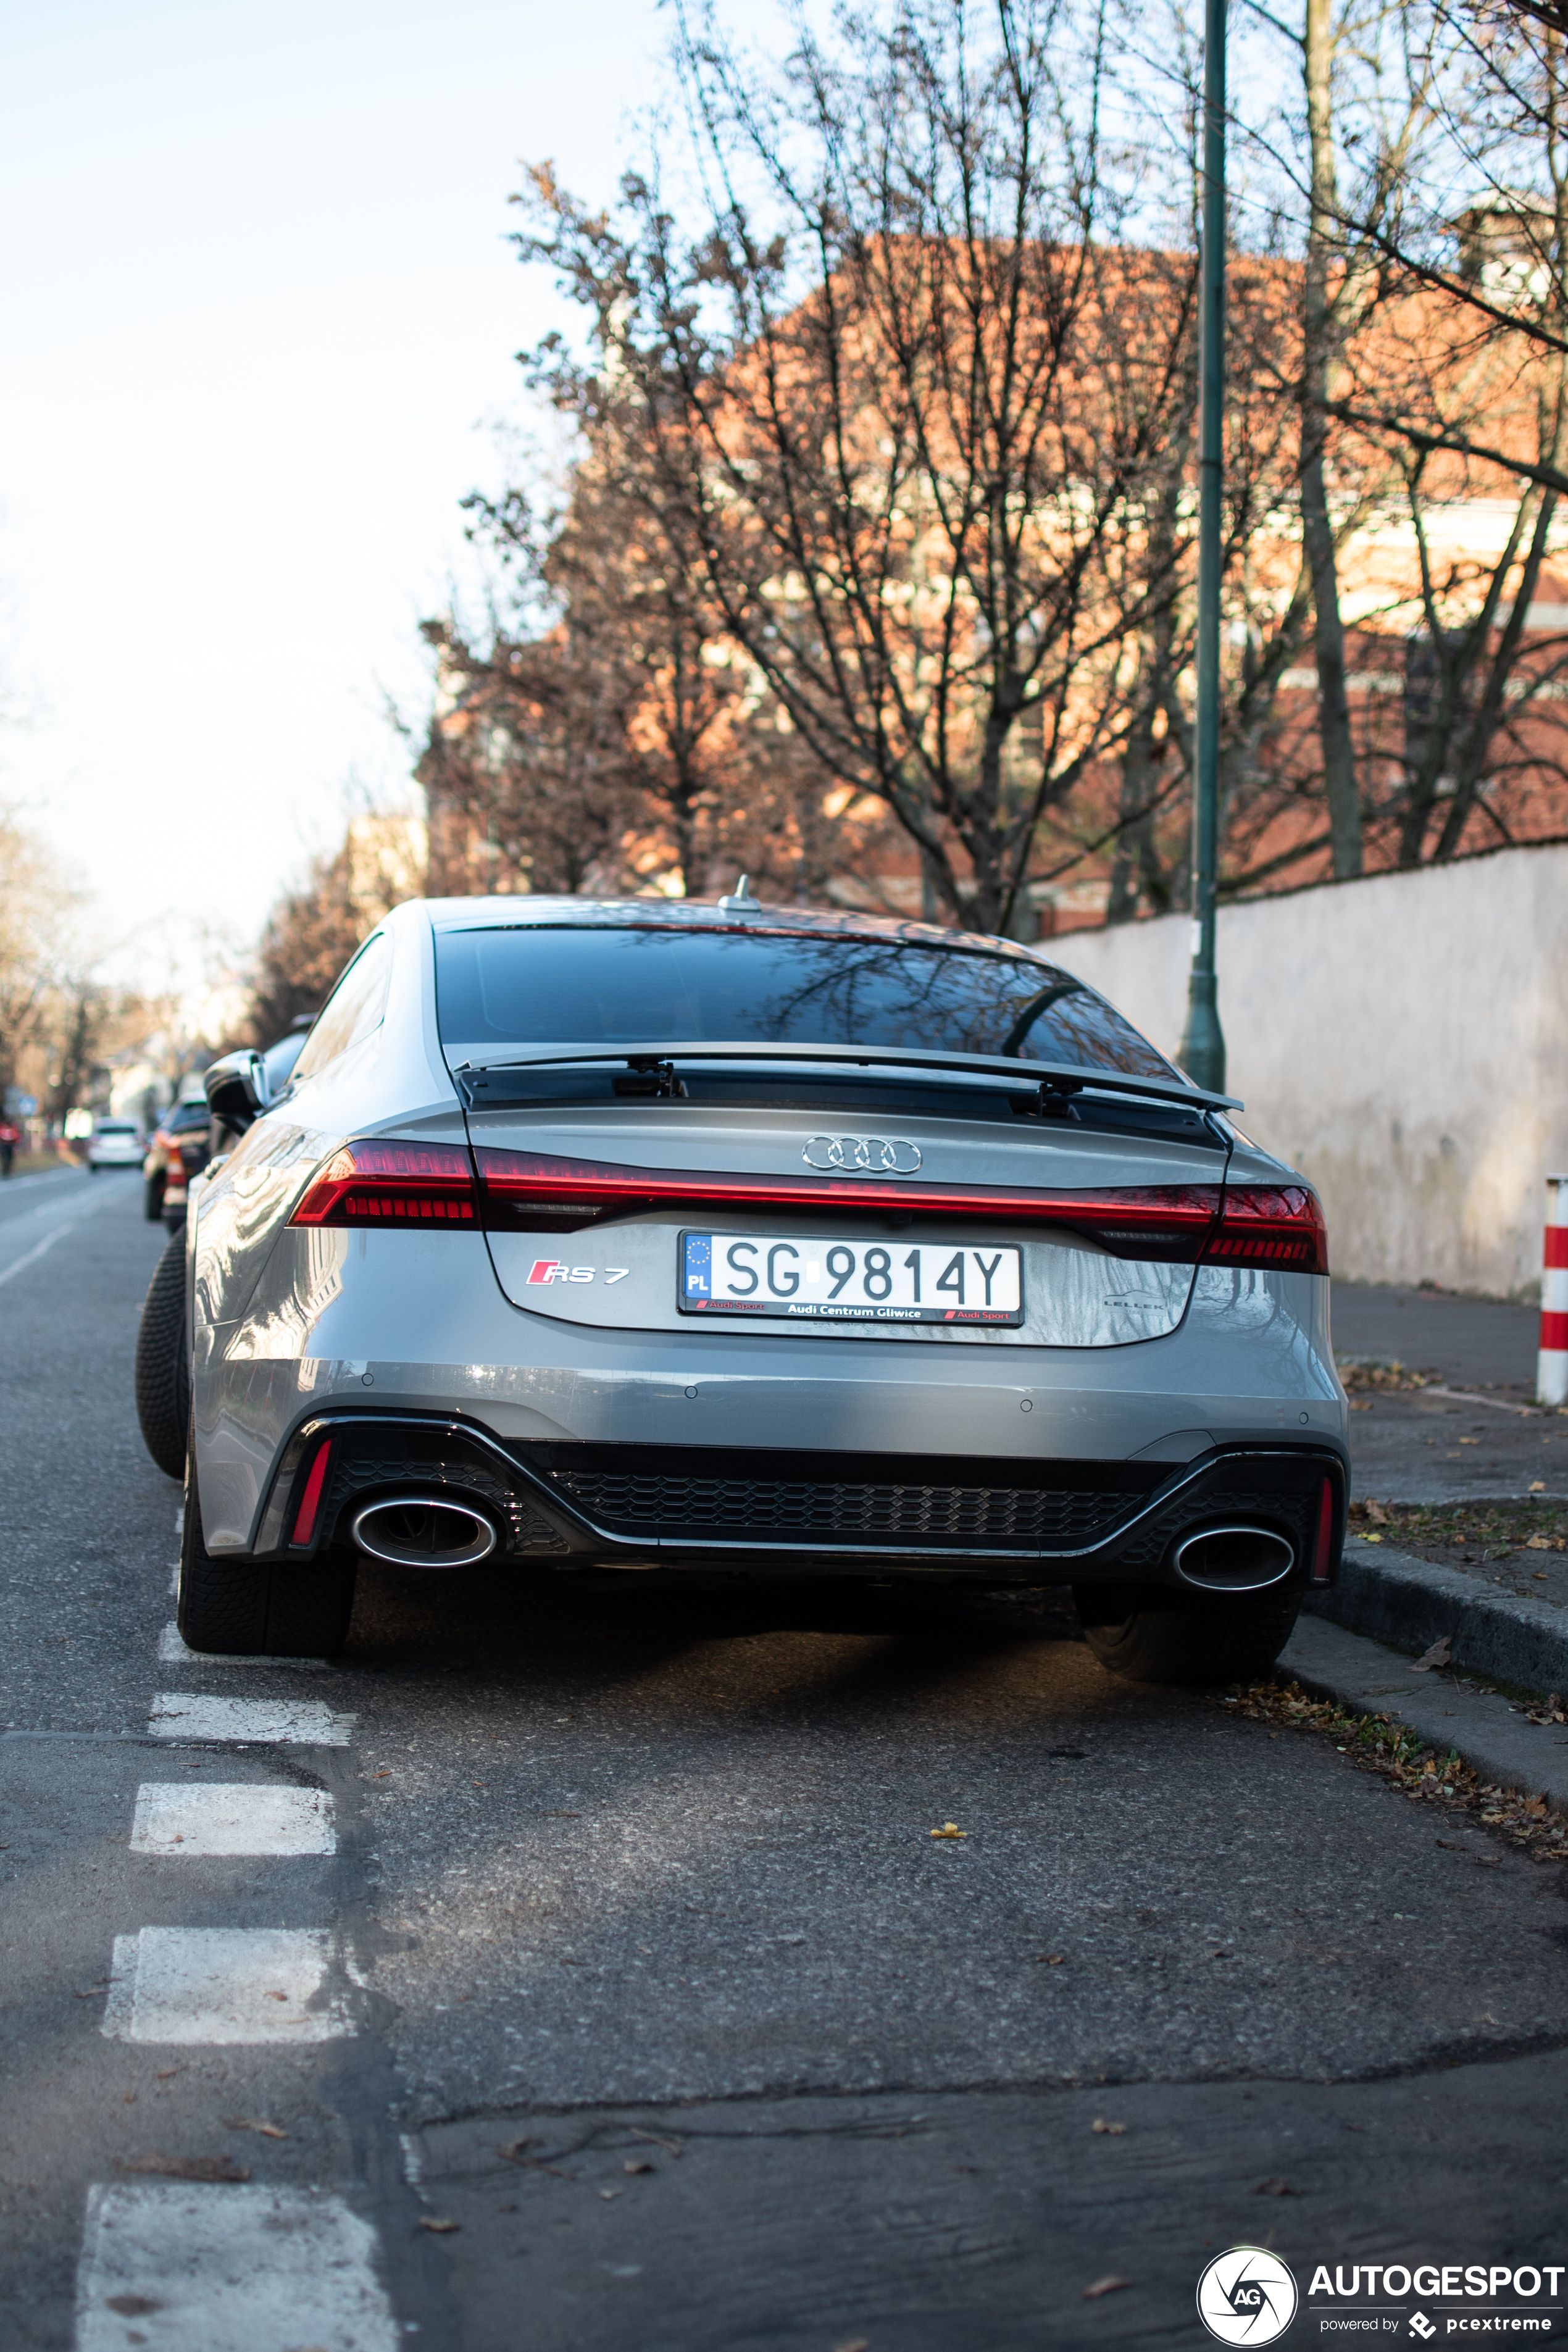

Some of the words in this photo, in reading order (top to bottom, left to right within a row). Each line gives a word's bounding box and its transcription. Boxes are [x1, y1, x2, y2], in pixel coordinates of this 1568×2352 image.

[543, 1266, 596, 1283] RS
[604, 1267, 630, 1285] 7
[726, 1242, 800, 1297] SG
[825, 1245, 1003, 1306] 9814Y
[688, 1275, 709, 1291] PL
[710, 1301, 733, 1309] Audi
[735, 1302, 764, 1311] Sport
[788, 1304, 817, 1314] Audi
[820, 1306, 874, 1316] Centrum
[877, 1308, 922, 1318] Gliwice
[1104, 1301, 1164, 1310] LELLEK
[957, 1311, 980, 1319] Audi
[982, 1312, 1010, 1320] Sport
